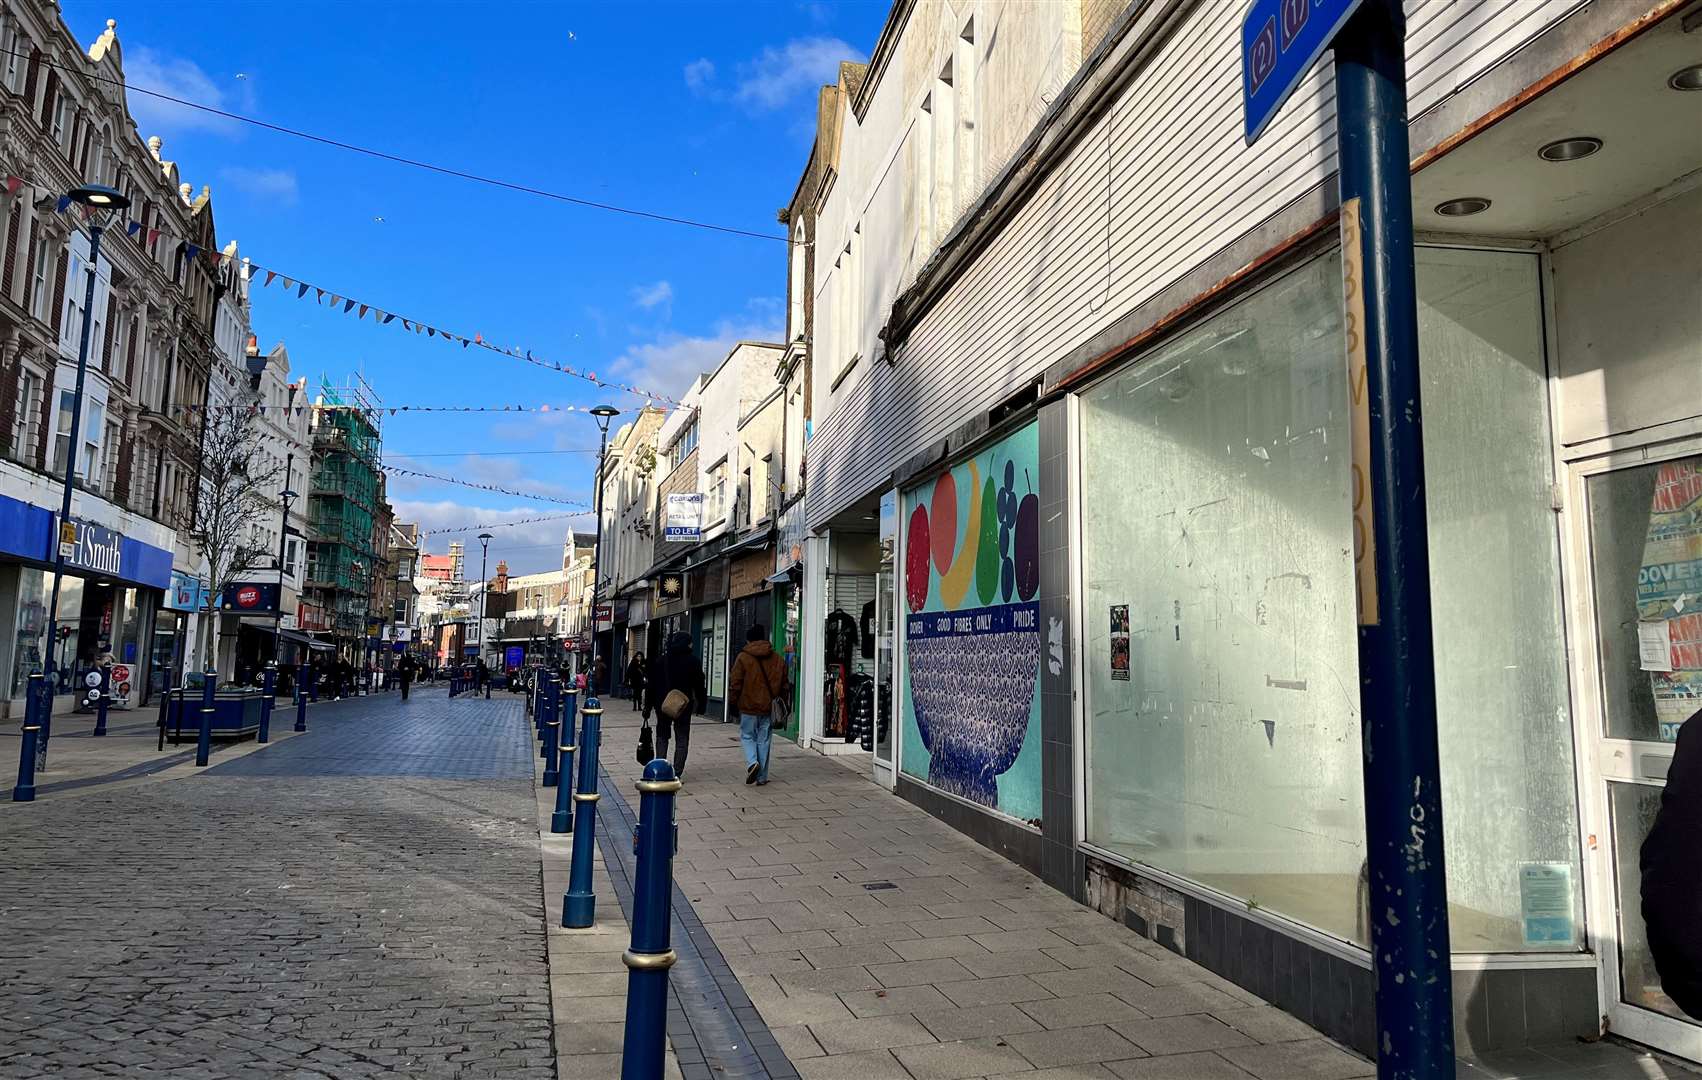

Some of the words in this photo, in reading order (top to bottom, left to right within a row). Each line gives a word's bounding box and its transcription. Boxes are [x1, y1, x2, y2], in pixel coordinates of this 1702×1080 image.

[1253, 28, 1272, 84] (2)
[670, 527, 681, 535] TO
[682, 527, 696, 535] LET
[937, 617, 951, 632] GOOD
[976, 614, 992, 630] ONLY
[1013, 609, 1035, 628] PRIDE
